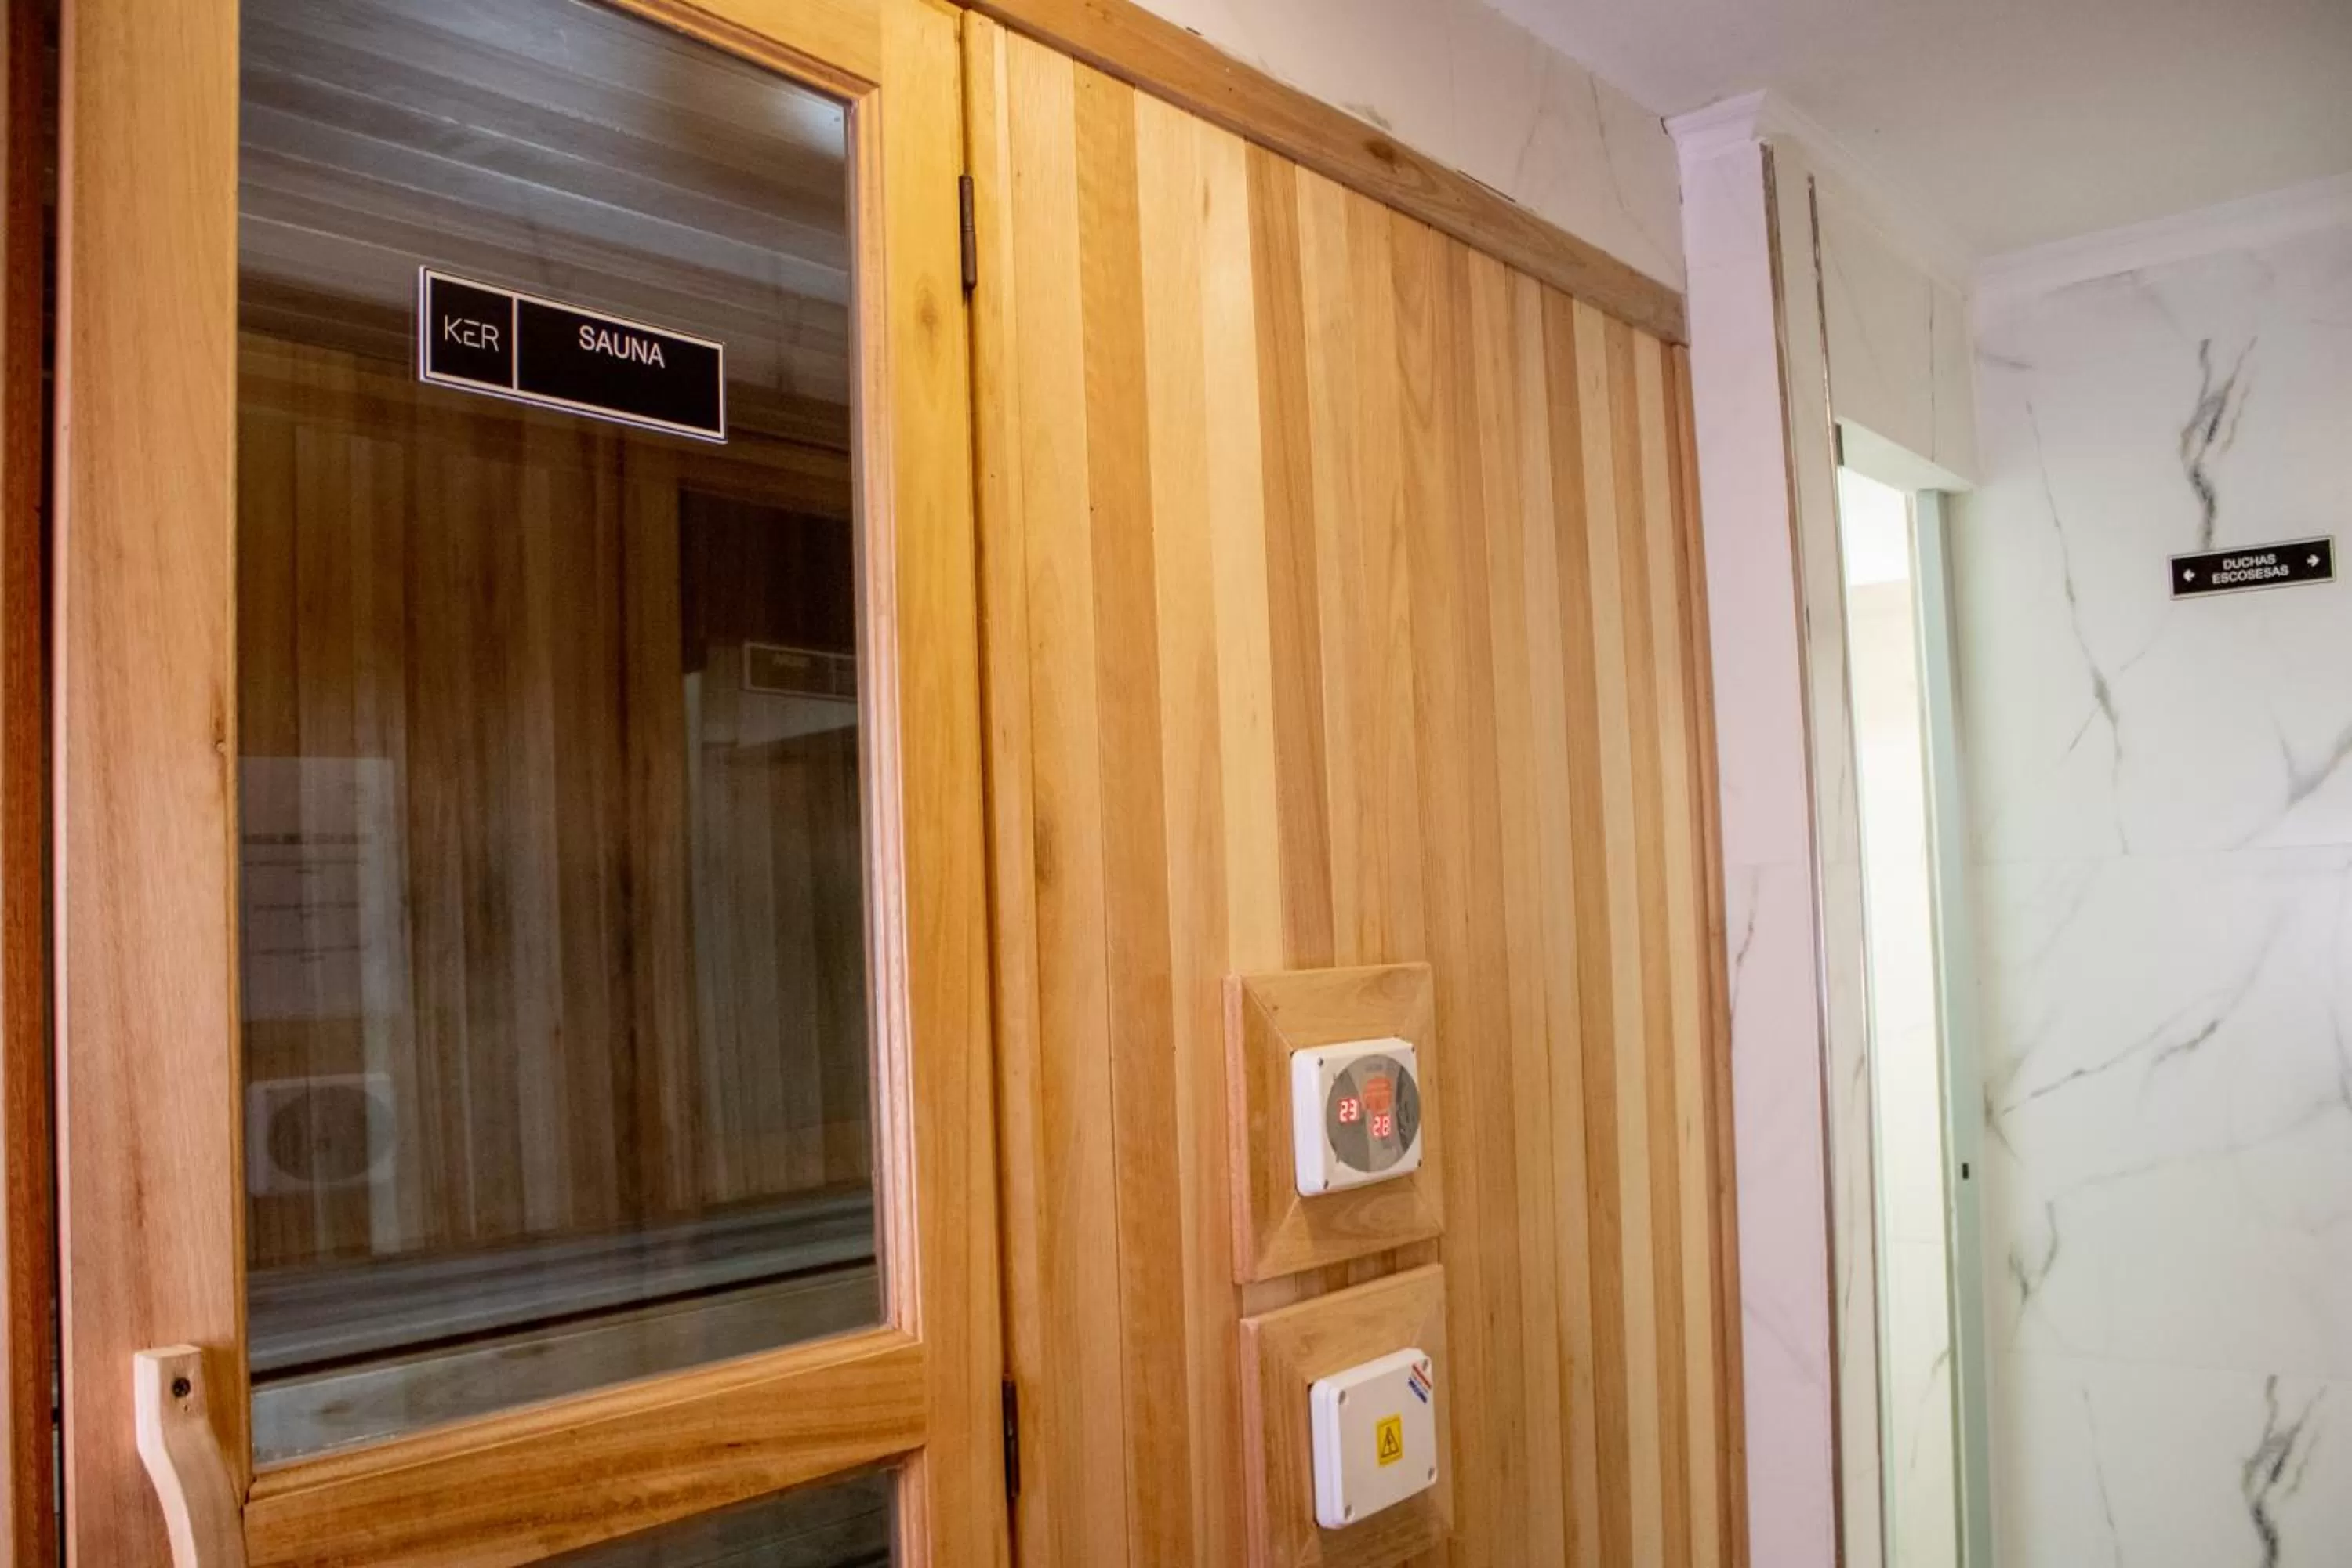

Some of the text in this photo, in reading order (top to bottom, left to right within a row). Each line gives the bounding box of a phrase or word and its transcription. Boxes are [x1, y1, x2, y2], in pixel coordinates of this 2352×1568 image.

[445, 314, 499, 351] KER
[579, 325, 666, 368] SAUNA
[2212, 565, 2289, 584] ESCOSESAS
[2223, 554, 2276, 570] DUCHAS
[1339, 1098, 1358, 1123] 23
